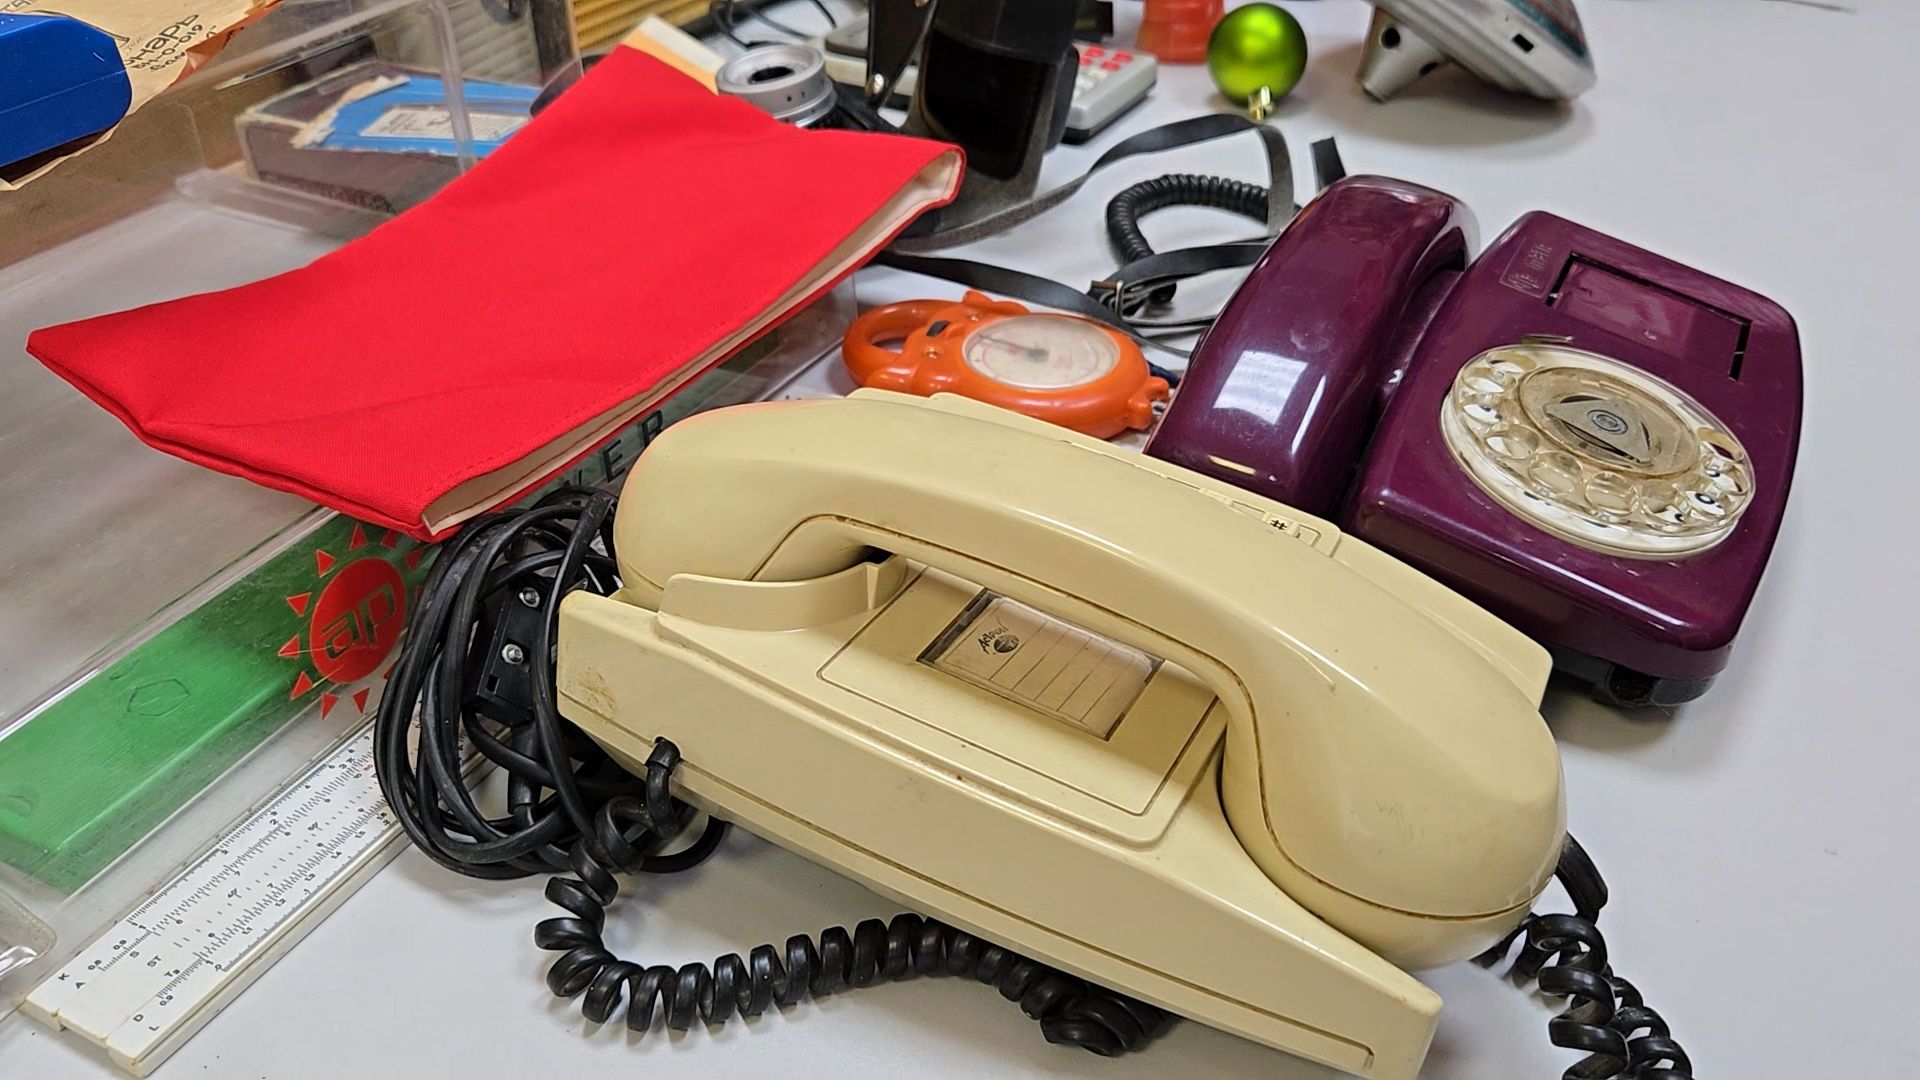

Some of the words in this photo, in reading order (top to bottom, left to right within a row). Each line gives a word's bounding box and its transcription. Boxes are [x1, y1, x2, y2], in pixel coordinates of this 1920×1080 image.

[129, 950, 140, 959] S
[146, 954, 163, 968] ST
[58, 972, 70, 981] K
[75, 981, 86, 990] A
[132, 1013, 145, 1023] D
[148, 1024, 160, 1032] L
